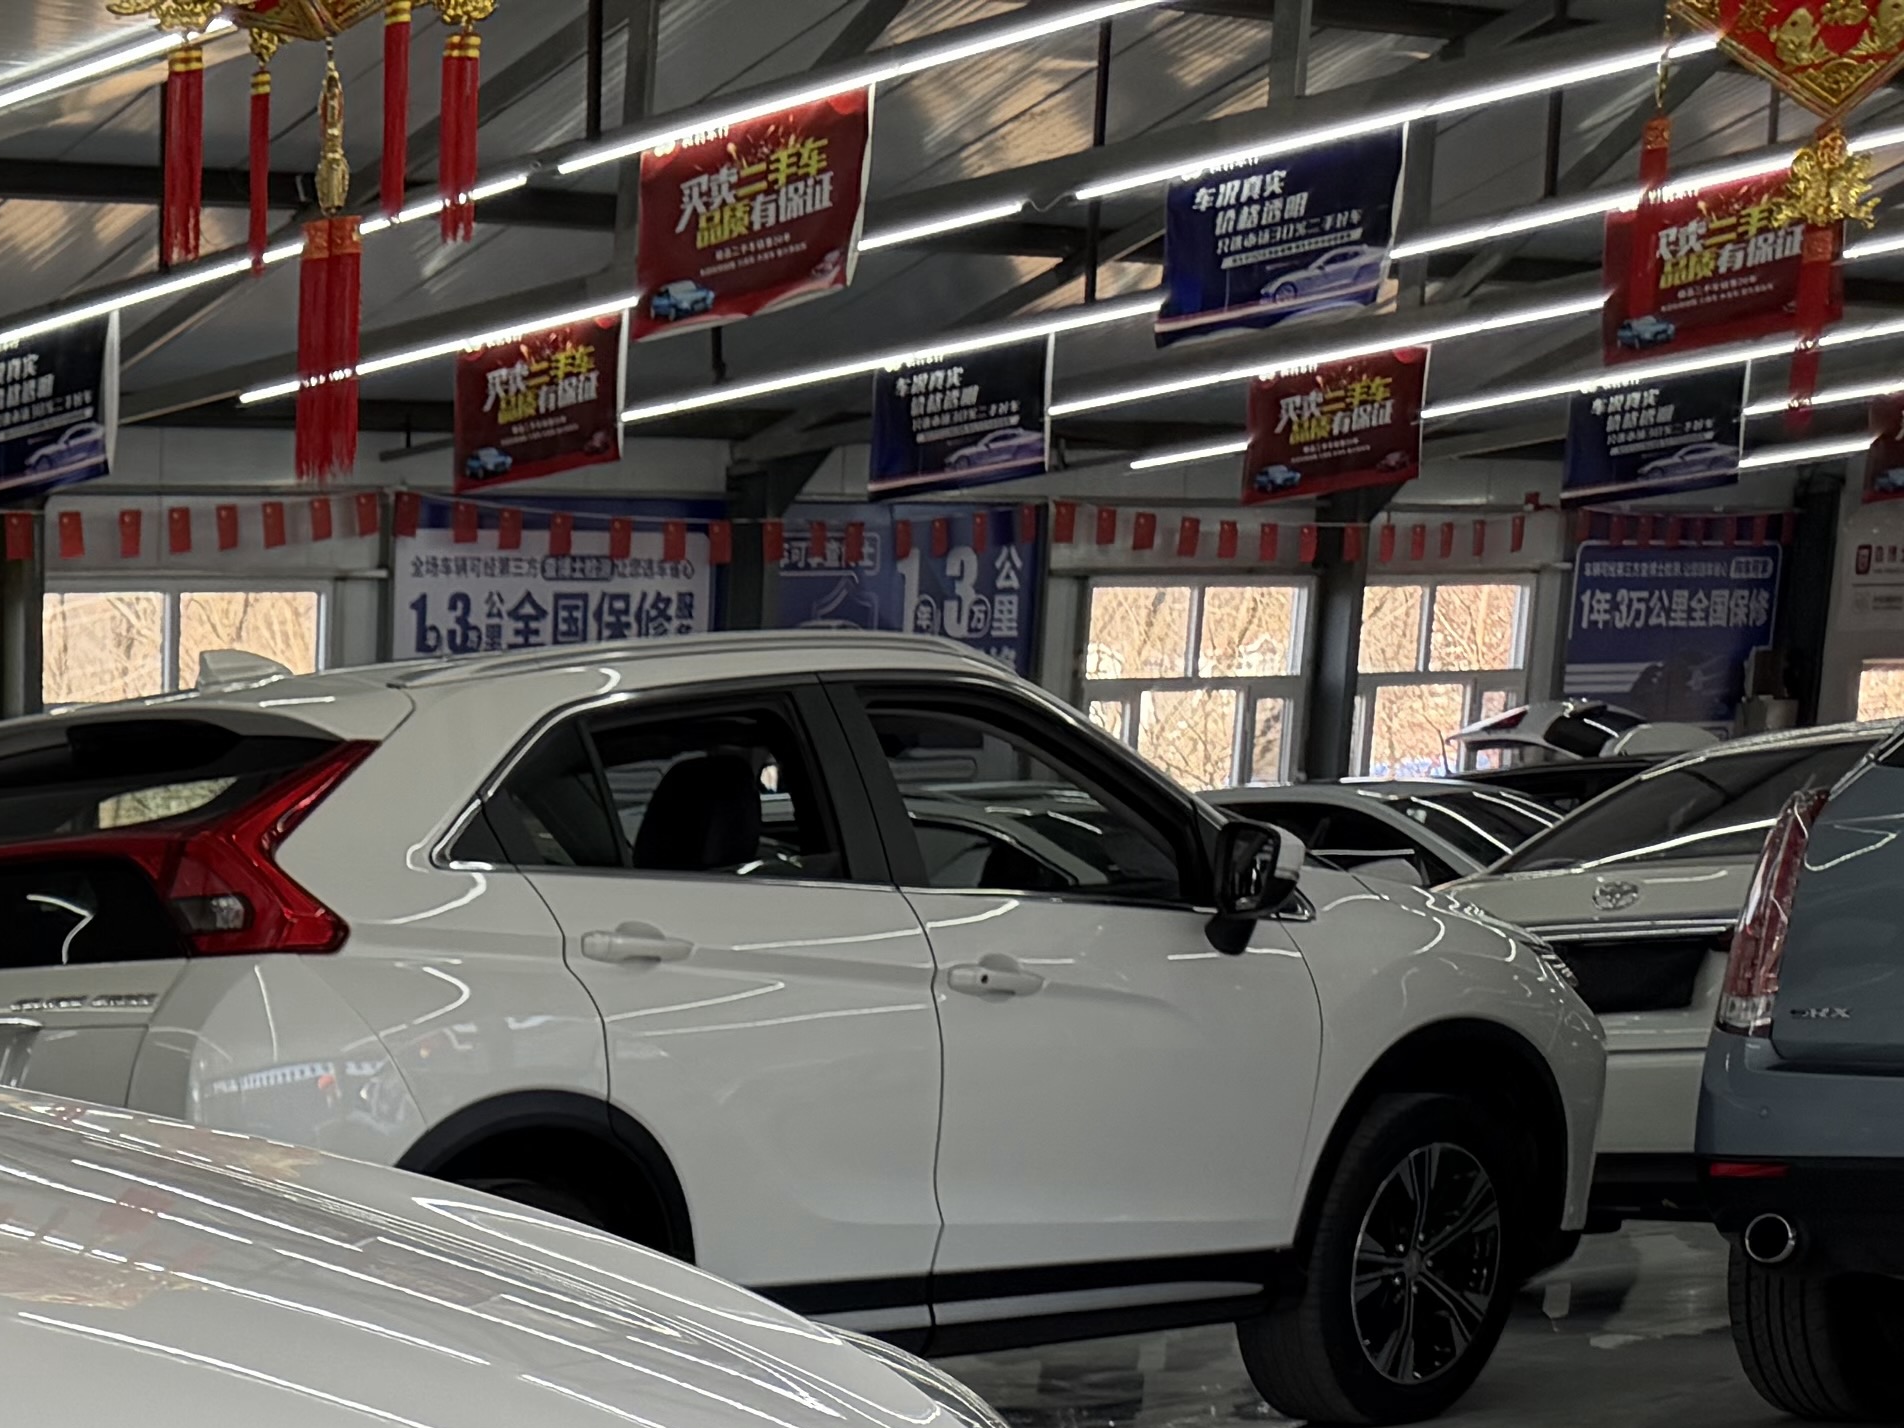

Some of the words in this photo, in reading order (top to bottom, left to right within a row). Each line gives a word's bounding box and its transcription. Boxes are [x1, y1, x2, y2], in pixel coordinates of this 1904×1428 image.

[675, 136, 829, 233] 买卖二手车
[696, 171, 834, 250] 品质有保证
[1656, 197, 1778, 262] 买卖二手
[1580, 588, 1771, 630] 1年3万公里全国保修
